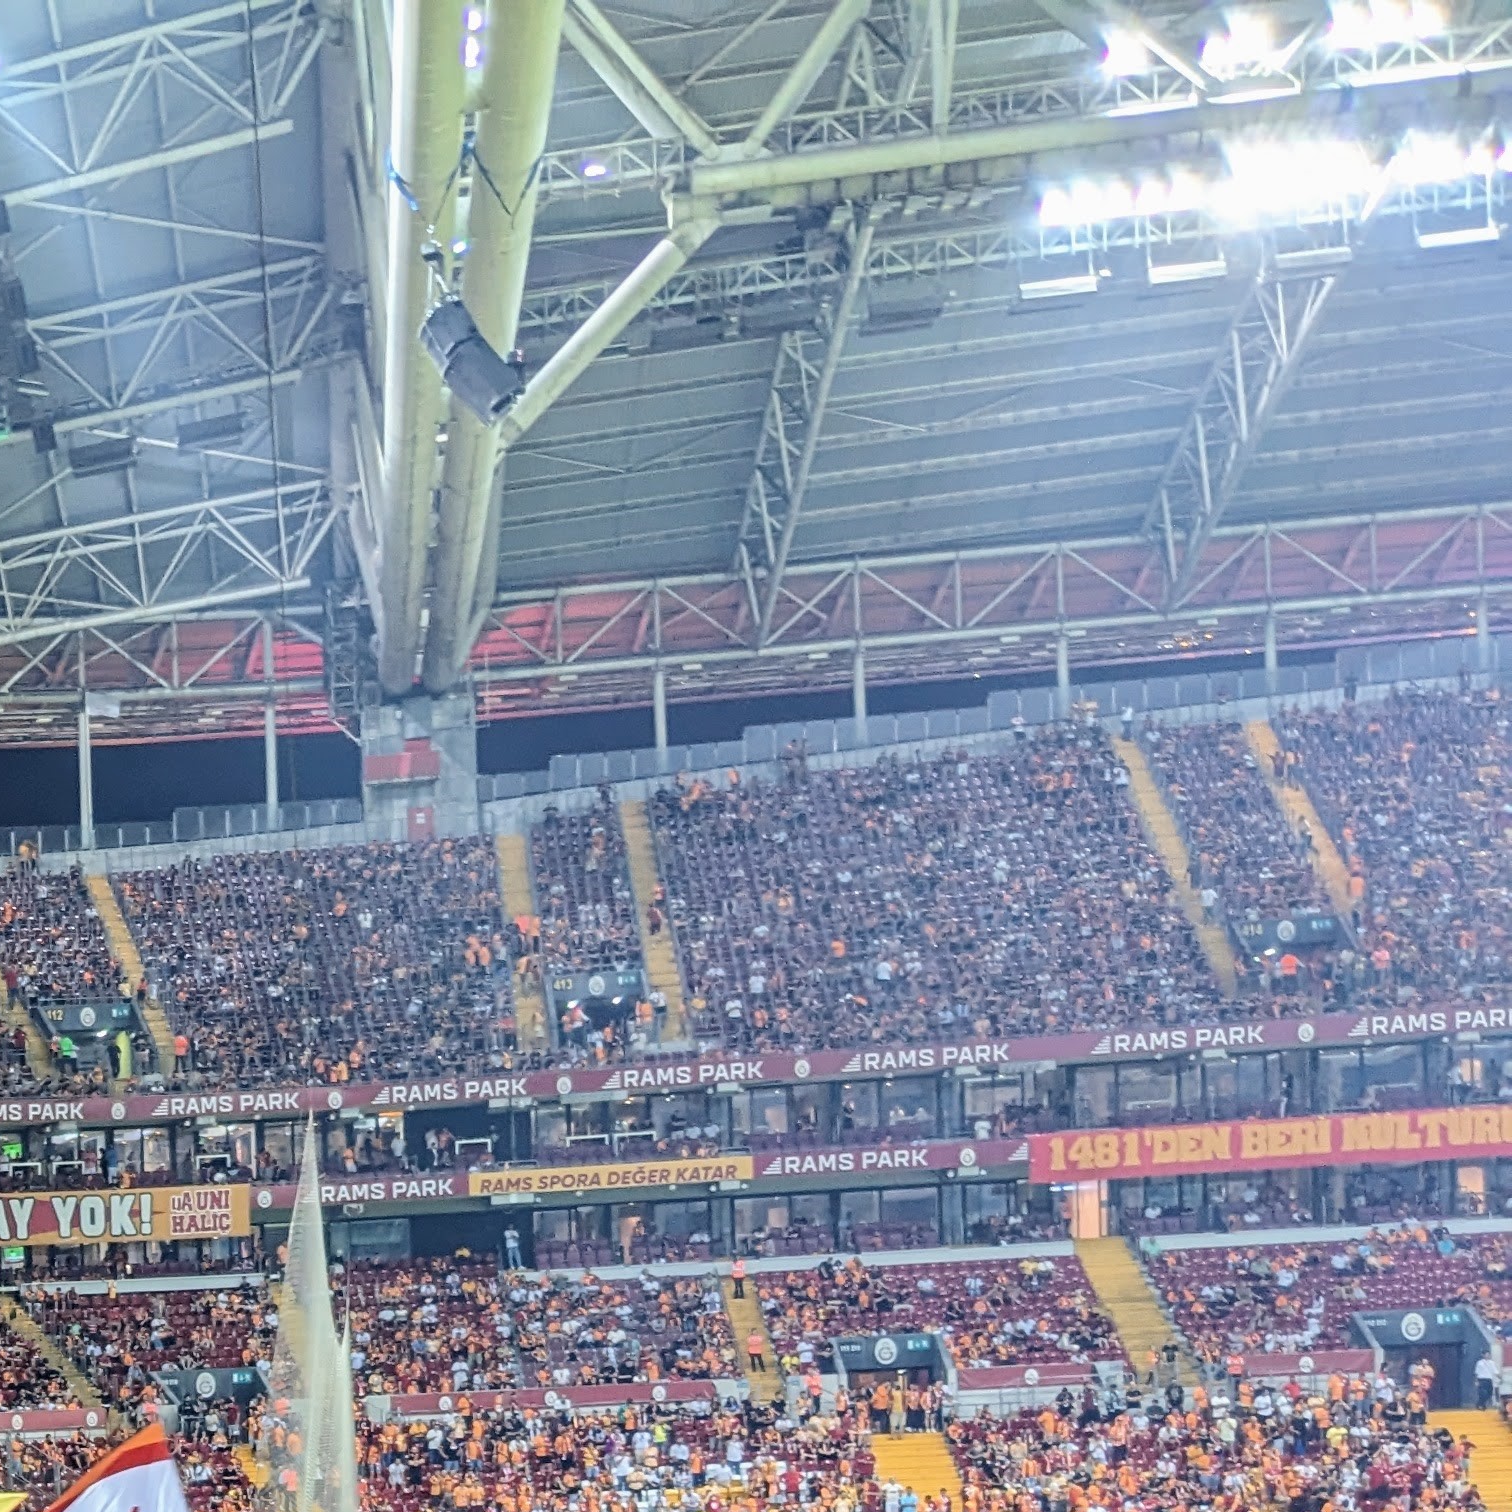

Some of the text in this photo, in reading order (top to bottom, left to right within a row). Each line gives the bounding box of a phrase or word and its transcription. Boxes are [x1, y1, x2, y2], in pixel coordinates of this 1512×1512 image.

[1372, 1008, 1512, 1035] RAMS PAR
[1114, 1025, 1264, 1052] RAMS PARK
[865, 1043, 1009, 1071] RAMS PARK
[624, 1061, 763, 1088] RAMS PARK
[393, 1077, 527, 1103] RAMS PARK
[29, 1102, 84, 1121] PARK
[171, 1092, 299, 1116] RAMS PARK
[784, 1149, 928, 1174] RAMS PARK
[321, 1178, 453, 1203] RAMS PARK
[480, 1164, 737, 1195] RAMS SPORA DEĞER KATAR
[51, 1194, 152, 1238] YOK!
